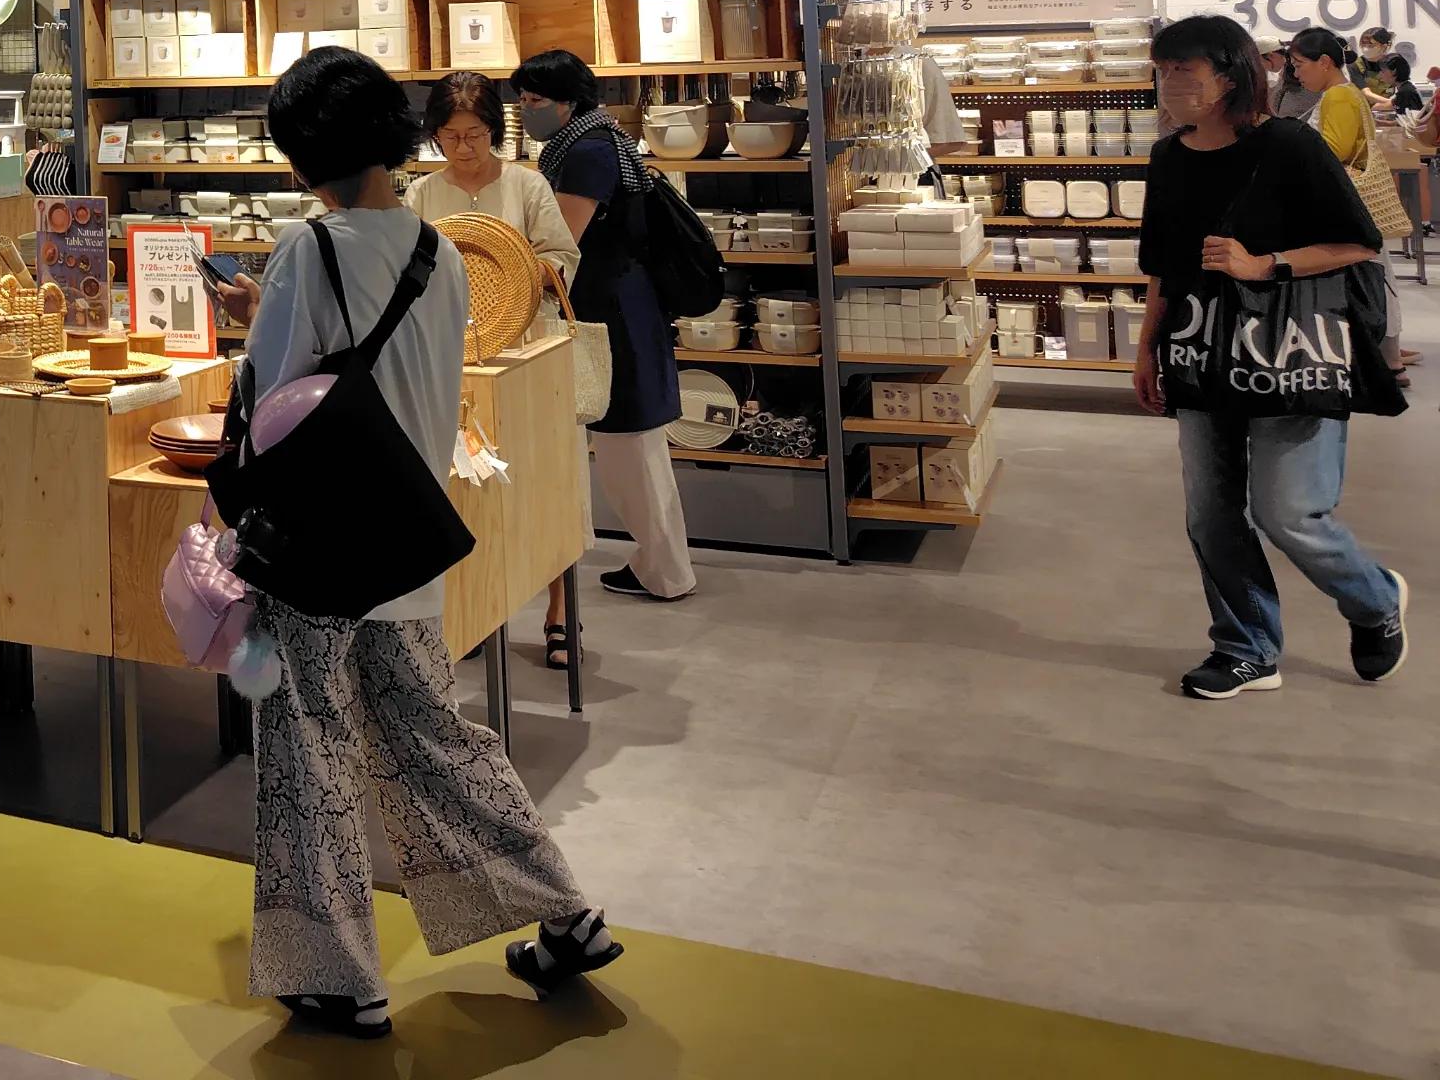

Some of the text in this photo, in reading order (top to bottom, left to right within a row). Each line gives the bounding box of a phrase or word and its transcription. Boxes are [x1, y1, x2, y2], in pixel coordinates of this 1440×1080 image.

[77, 227, 104, 238] Natural
[65, 236, 105, 247] Table Wear
[148, 252, 190, 261] プレゼント
[1229, 366, 1332, 396] COFFEE
